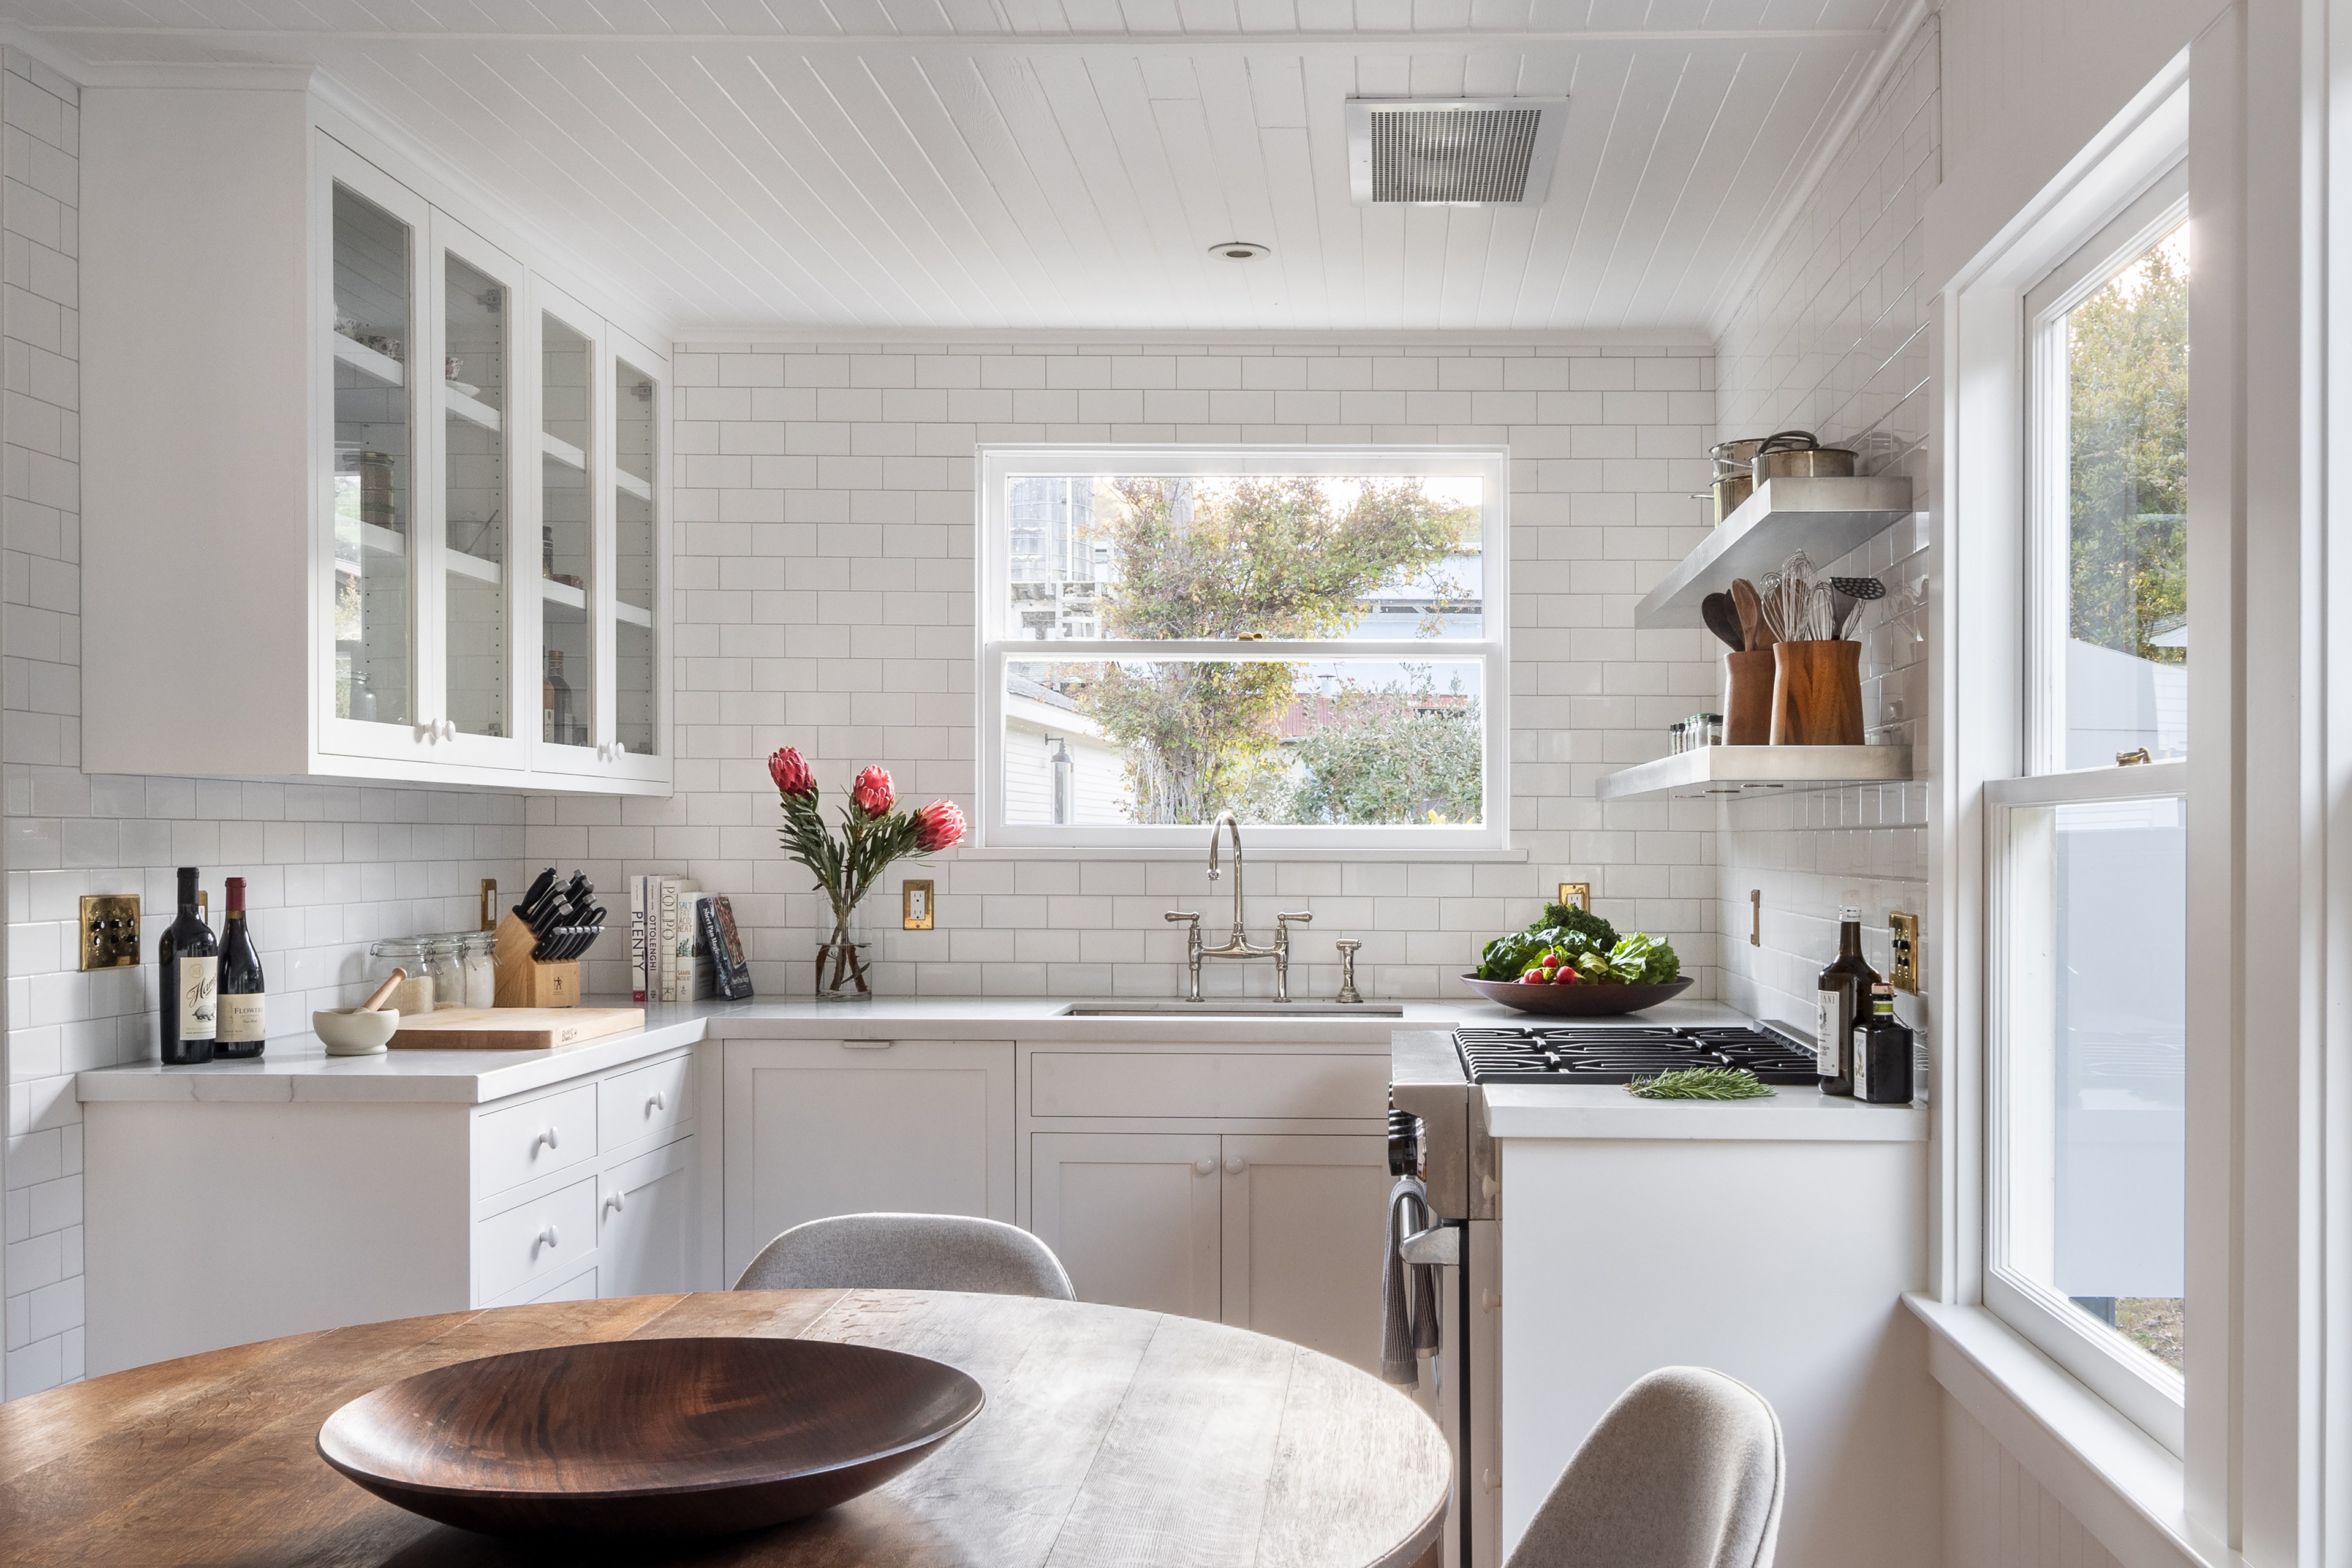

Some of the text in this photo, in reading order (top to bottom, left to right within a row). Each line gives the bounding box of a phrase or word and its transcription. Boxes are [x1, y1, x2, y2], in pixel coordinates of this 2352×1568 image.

[662, 886, 675, 940] POLPO
[678, 901, 692, 910] SALT
[632, 911, 645, 971] PLENTY
